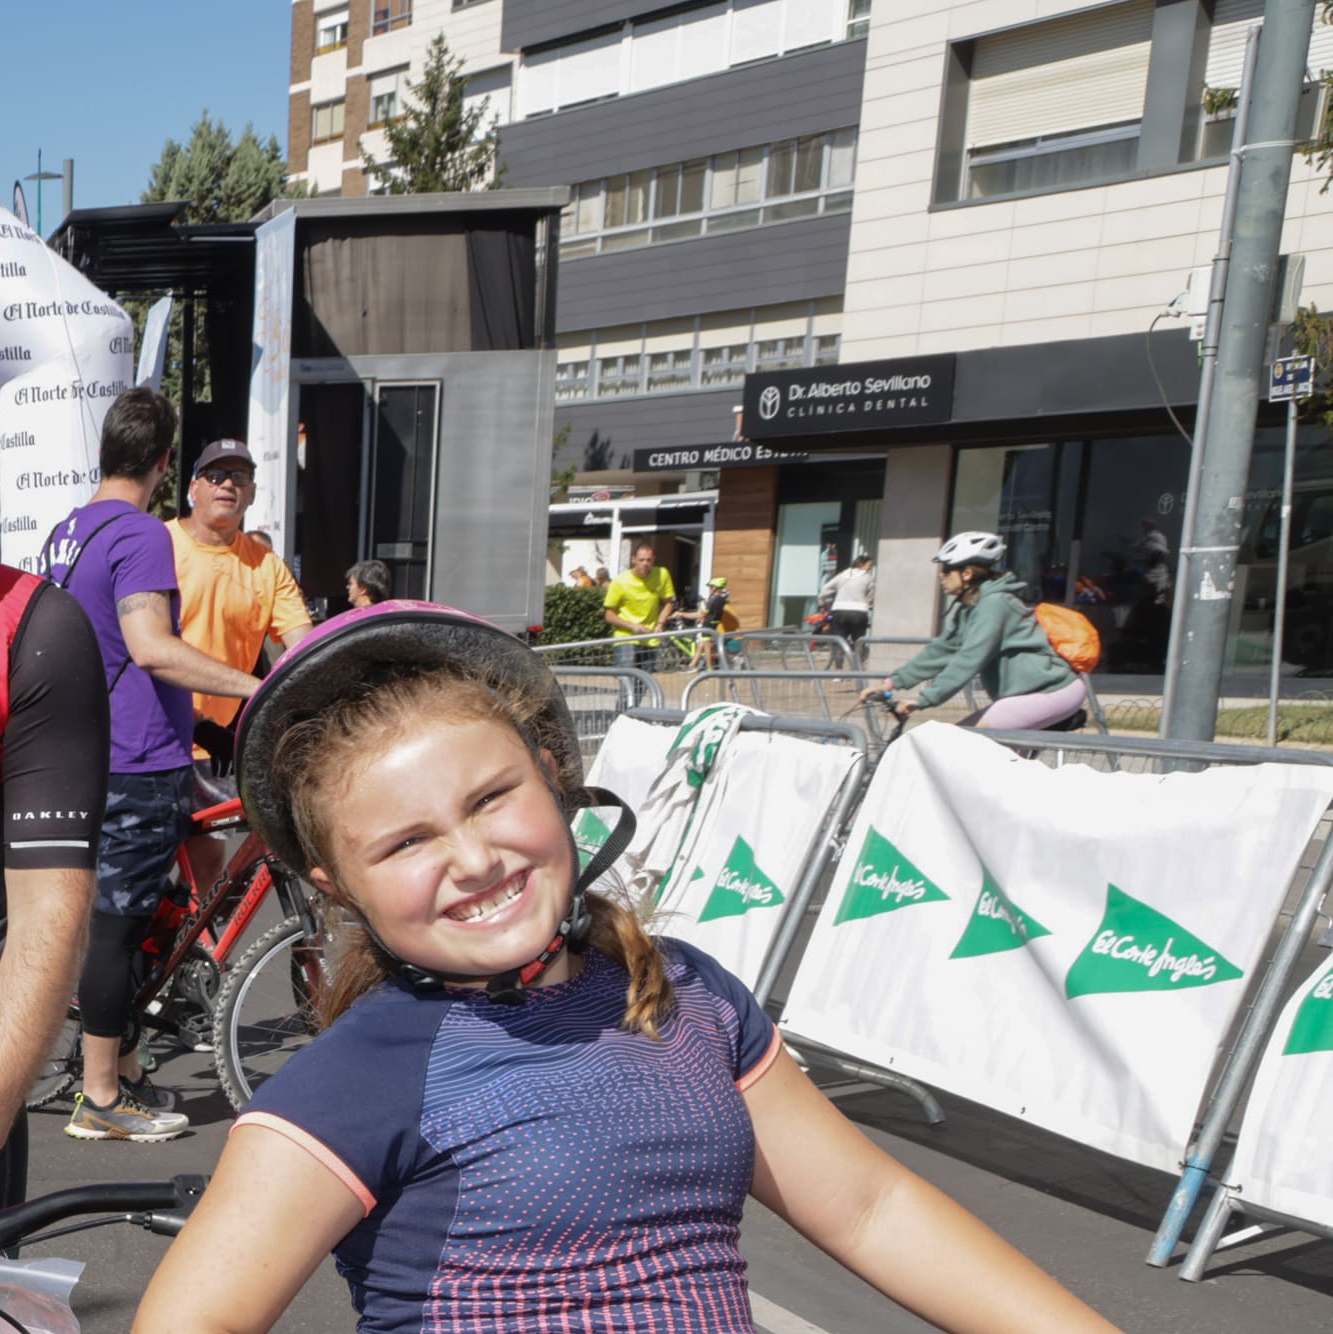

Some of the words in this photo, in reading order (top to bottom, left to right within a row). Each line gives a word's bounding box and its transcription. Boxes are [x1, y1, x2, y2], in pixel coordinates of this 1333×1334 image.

[4, 303, 23, 322] El
[27, 303, 63, 319] Norte
[66, 301, 81, 317] de
[14, 386, 30, 406] El
[32, 384, 67, 404] Norte
[86, 379, 129, 400] Castill
[789, 384, 807, 401] Dr.
[808, 379, 862, 398] Alberto
[865, 374, 932, 395] Sevillano
[864, 396, 929, 412] DENTAL
[649, 449, 700, 466] CENTRO
[704, 446, 753, 464] MÉDICO
[17, 472, 31, 491] El
[33, 471, 69, 489] Norte
[13, 809, 90, 822] OAKLEY
[1091, 930, 1114, 955] El
[1111, 934, 1154, 966] Corte
[1148, 937, 1218, 980] Inglés
